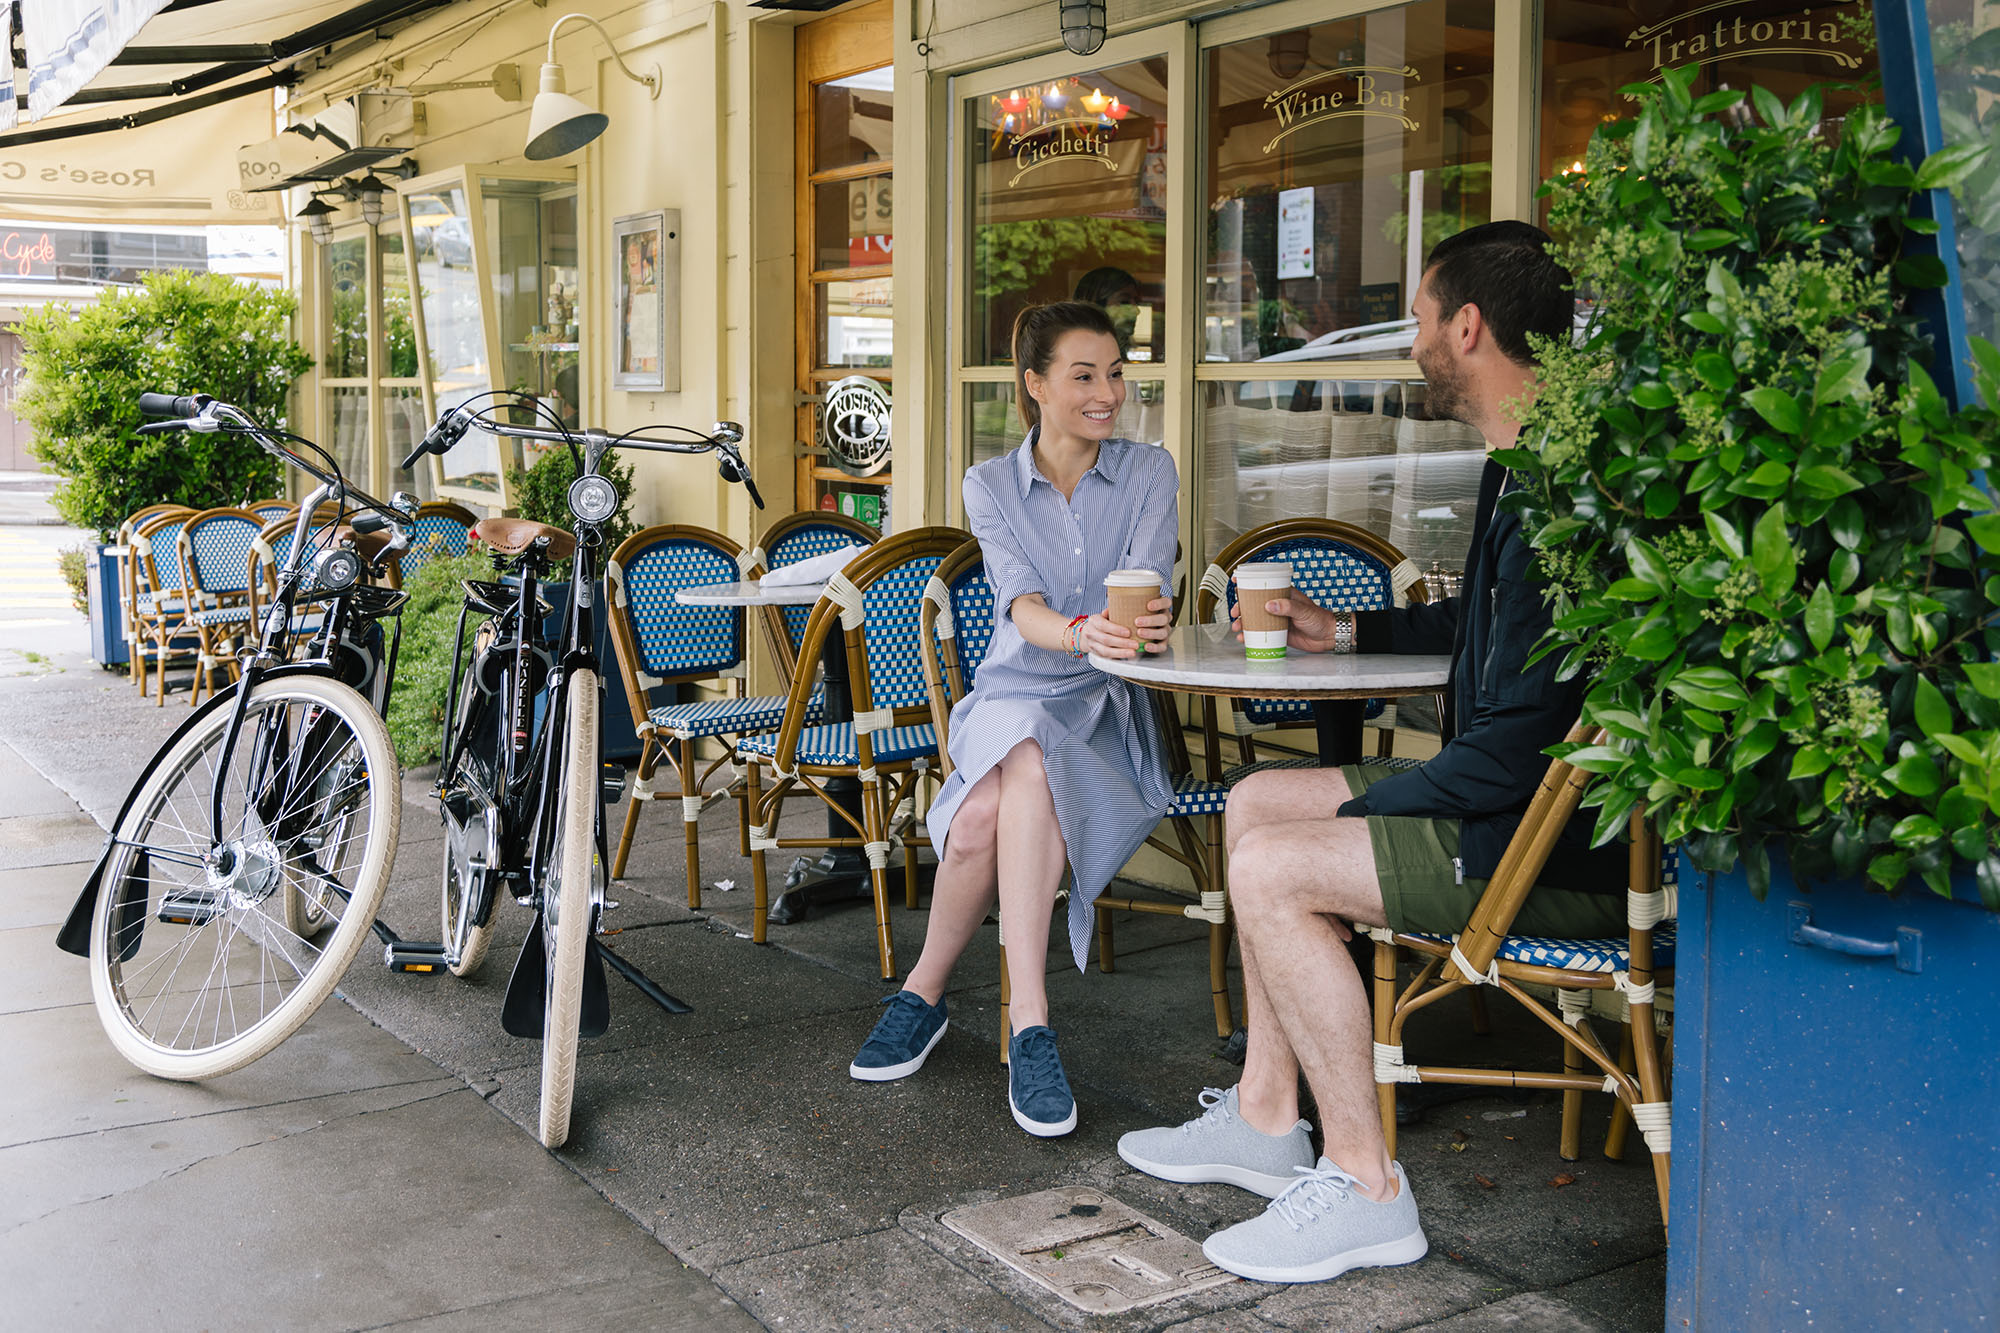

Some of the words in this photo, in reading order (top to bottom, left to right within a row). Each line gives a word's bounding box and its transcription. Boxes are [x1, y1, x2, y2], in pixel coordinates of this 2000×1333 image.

[1643, 8, 1841, 72] Trattoria
[1272, 89, 1344, 128] Wine
[1355, 75, 1410, 112] Bar
[1016, 124, 1111, 170] Cicchetti
[3, 232, 55, 276] Cycle
[516, 658, 529, 729] GAZELLE
